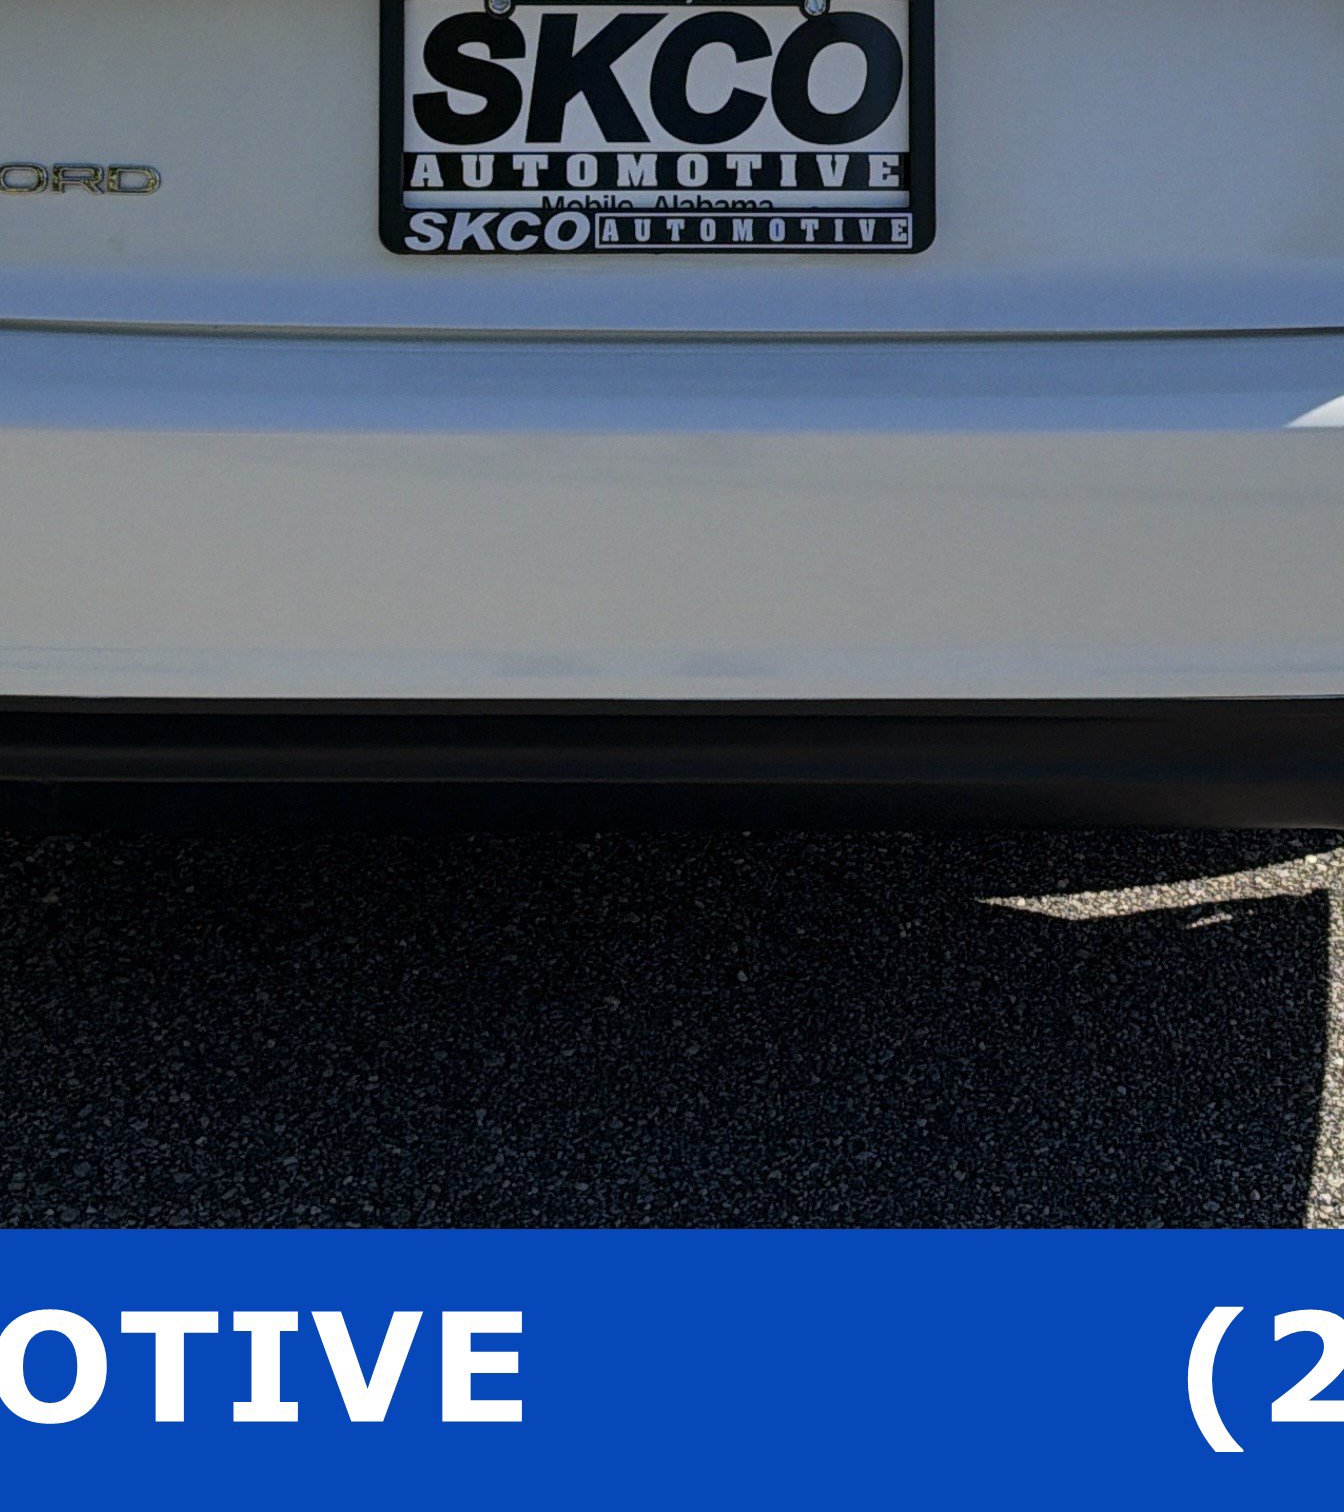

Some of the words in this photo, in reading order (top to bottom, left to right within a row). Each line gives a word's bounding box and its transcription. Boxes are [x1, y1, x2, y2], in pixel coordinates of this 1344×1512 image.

[412, 11, 904, 146] SKCO
[410, 153, 901, 188] AUTOMOTIVE
[404, 211, 591, 252] SKCO
[600, 218, 908, 244] AUTOMOTIVE
